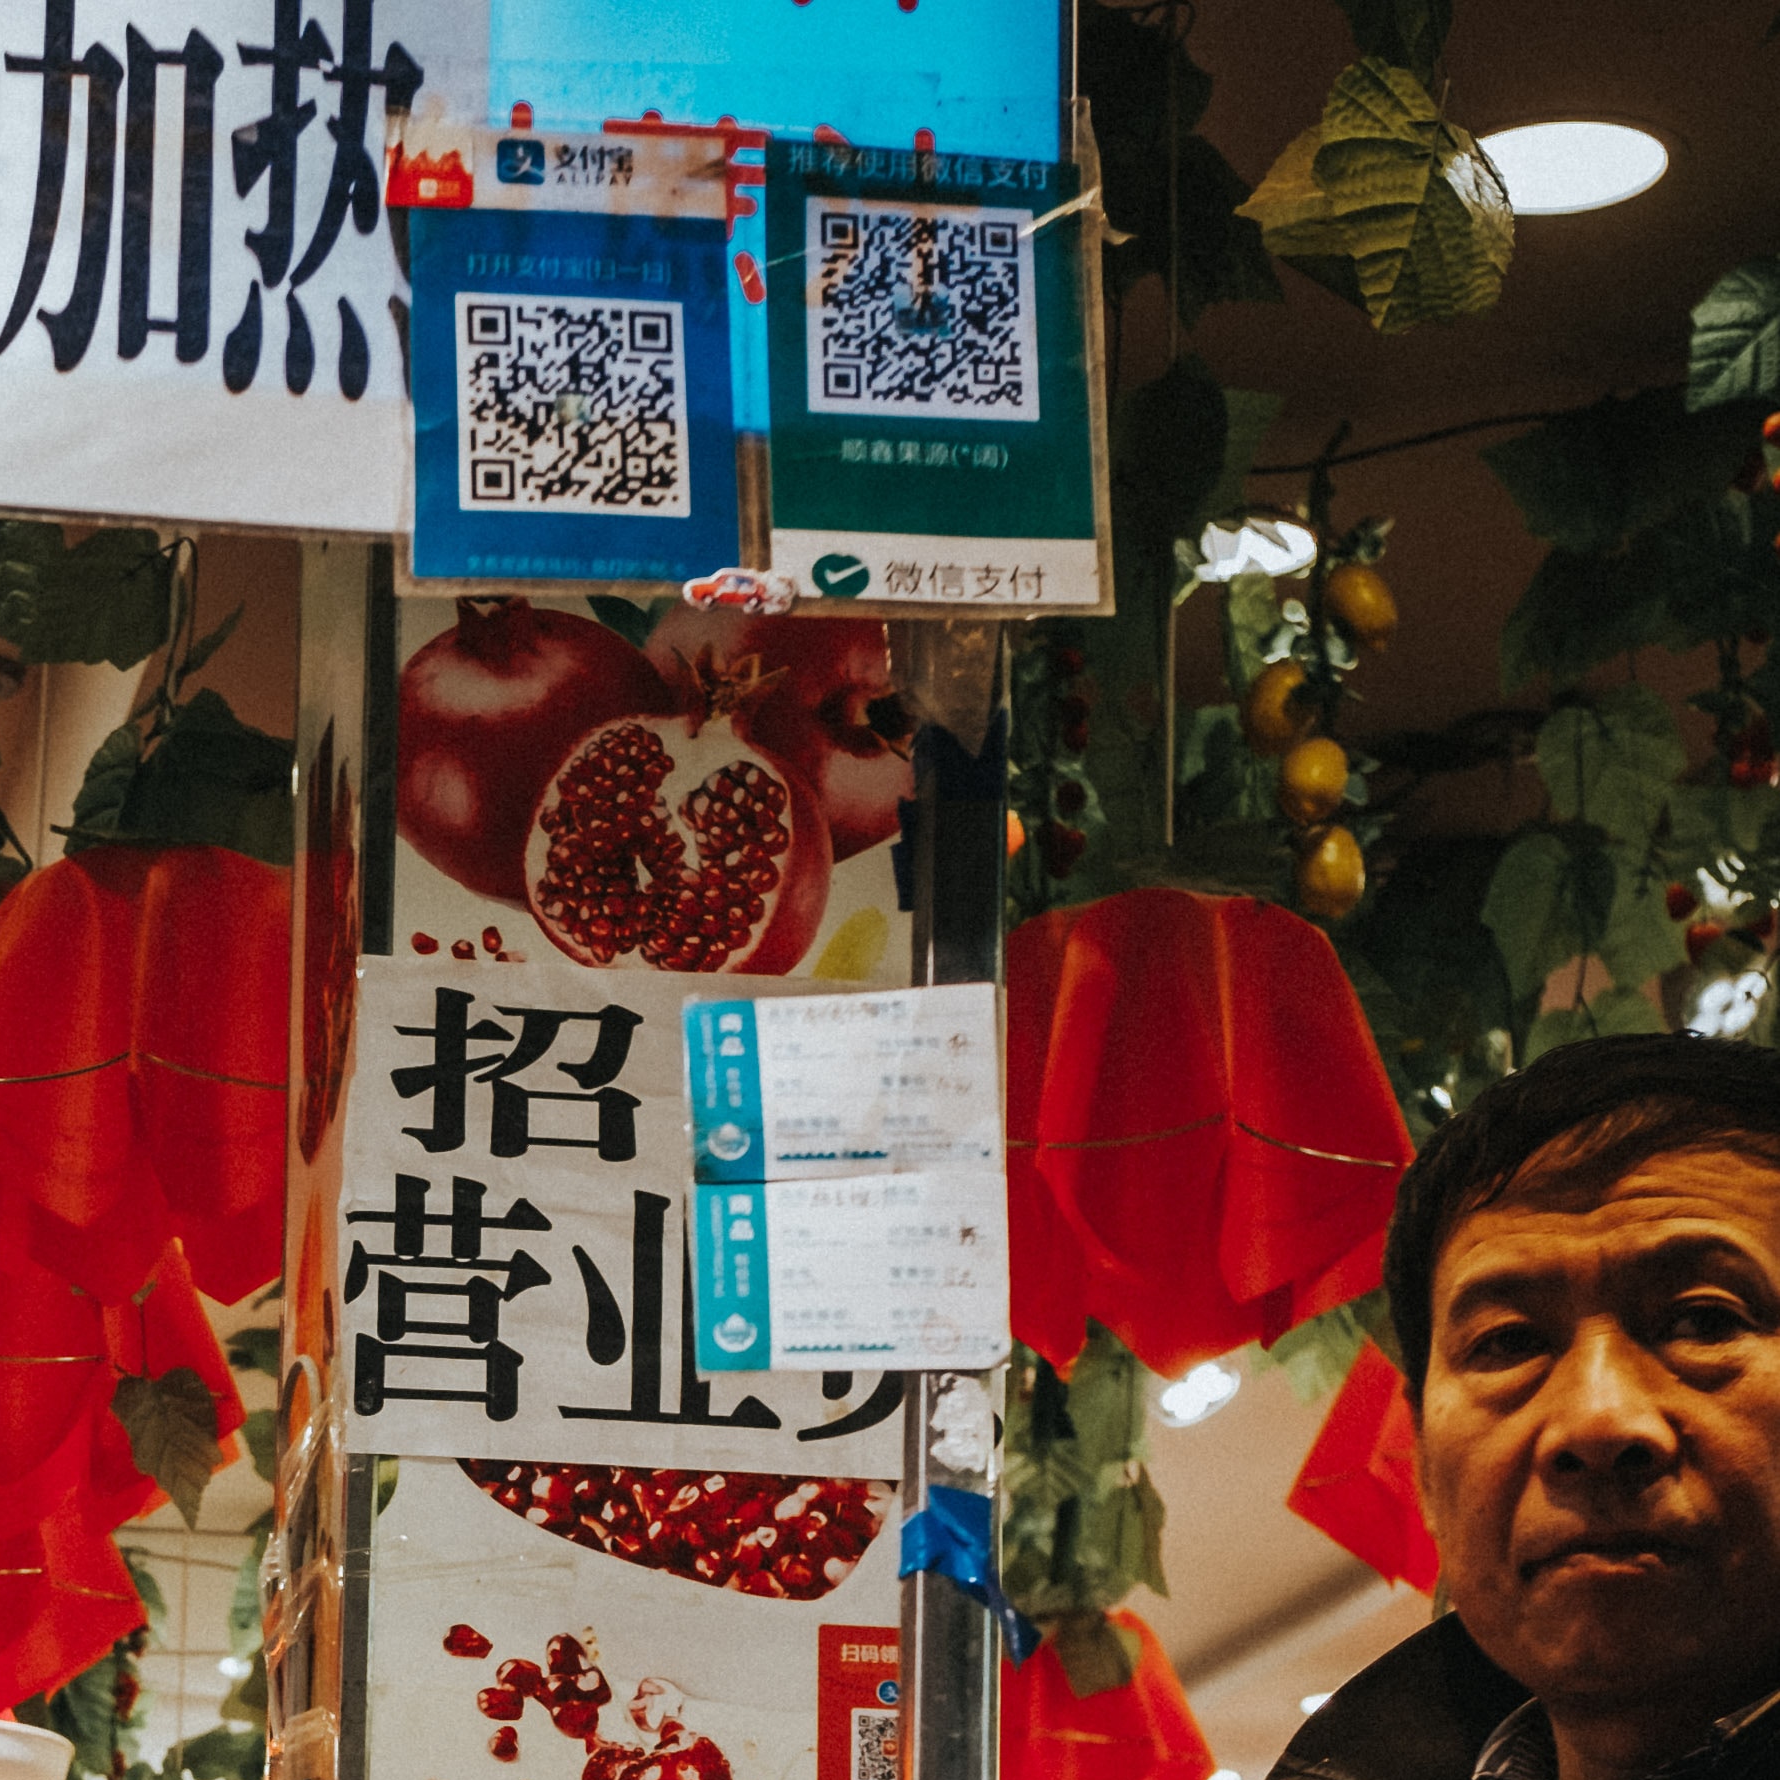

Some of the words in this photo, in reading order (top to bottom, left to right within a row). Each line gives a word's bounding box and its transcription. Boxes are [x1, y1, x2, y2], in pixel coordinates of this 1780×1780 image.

[885, 560, 1047, 600] 微信支付
[344, 1172, 906, 1442] 营业
